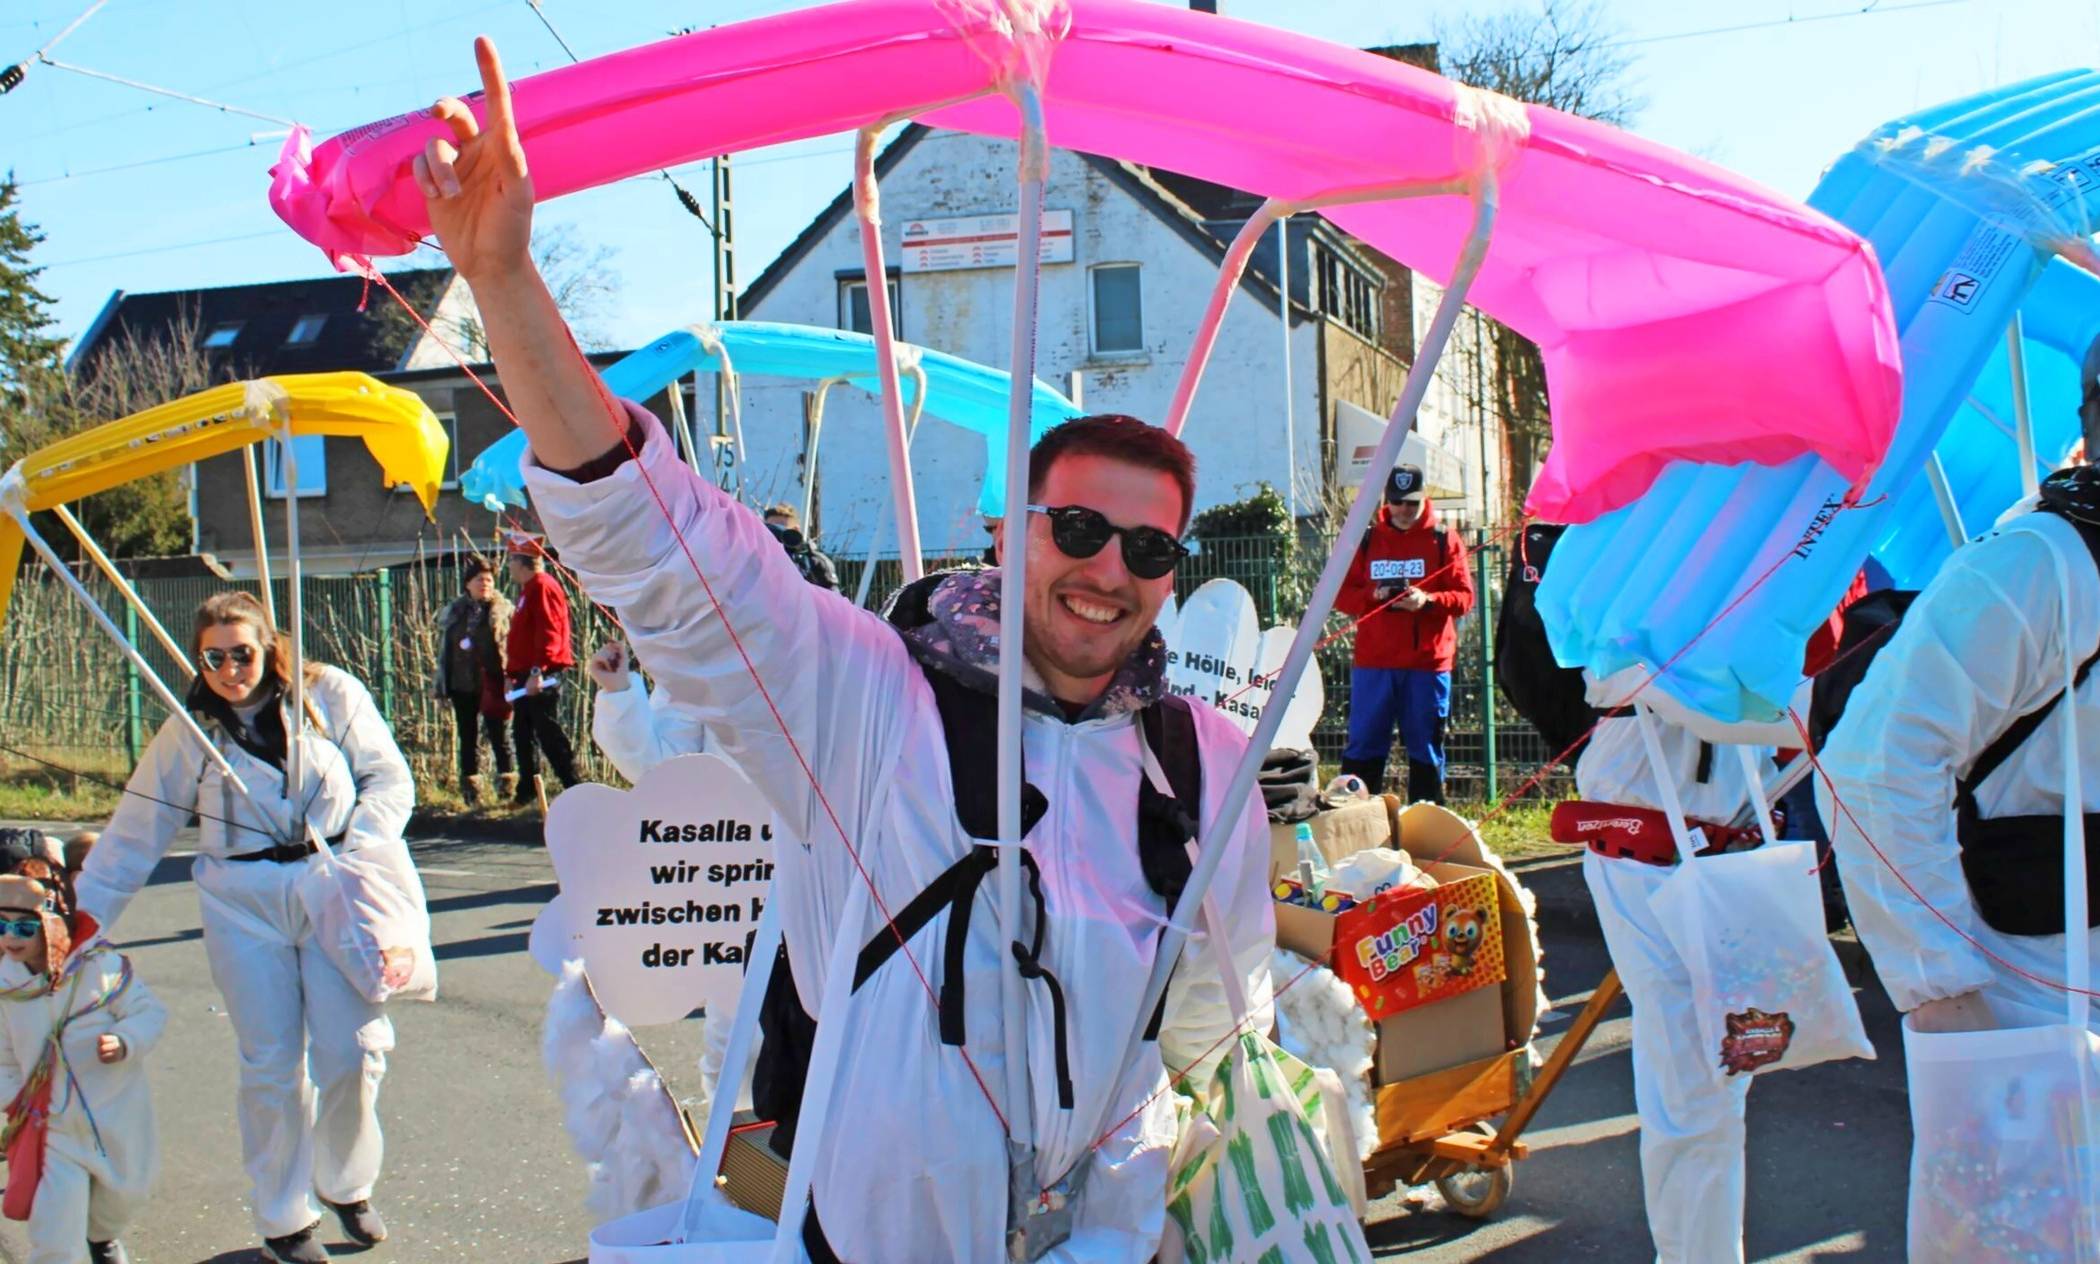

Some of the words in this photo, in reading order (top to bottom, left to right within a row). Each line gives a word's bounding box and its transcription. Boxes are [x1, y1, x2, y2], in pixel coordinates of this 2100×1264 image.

[1794, 497, 1842, 559] INTEX
[1167, 650, 1179, 664] e
[1185, 651, 1242, 685] Hölle,
[1214, 690, 1260, 721] Kasa
[640, 819, 752, 843] Kasalla
[761, 824, 773, 842] u
[650, 860, 700, 885] wir
[596, 900, 741, 926] zwischen
[1355, 902, 1438, 969] Funny
[642, 943, 695, 968] der
[703, 941, 743, 965] Ka
[1368, 936, 1421, 982] Bear
